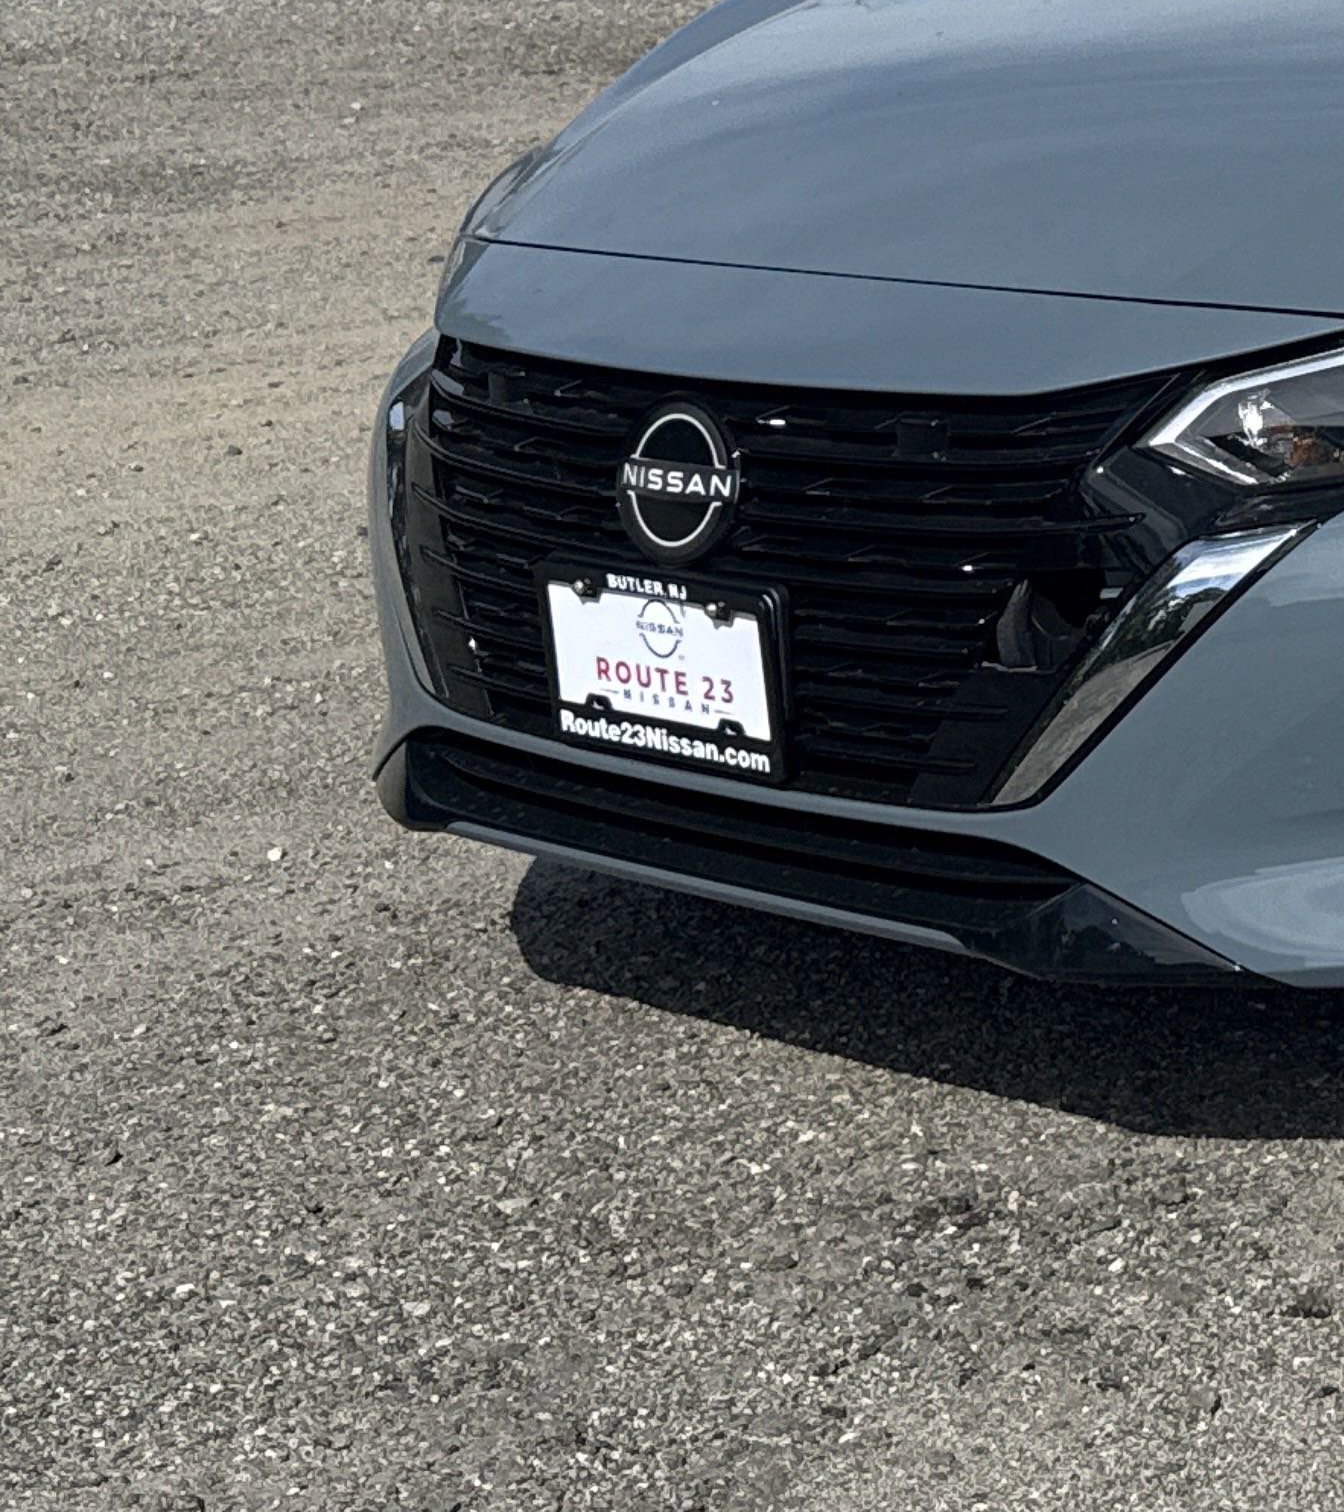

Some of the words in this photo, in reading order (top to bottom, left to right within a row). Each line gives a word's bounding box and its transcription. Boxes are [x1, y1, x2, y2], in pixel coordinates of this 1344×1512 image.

[622, 462, 732, 497] NISSAN
[636, 621, 684, 637] NISSAN
[596, 656, 689, 696] ROUTE
[702, 676, 734, 704] 23
[624, 688, 710, 715] NISSAN
[559, 708, 771, 773] Route23Nissan.com
